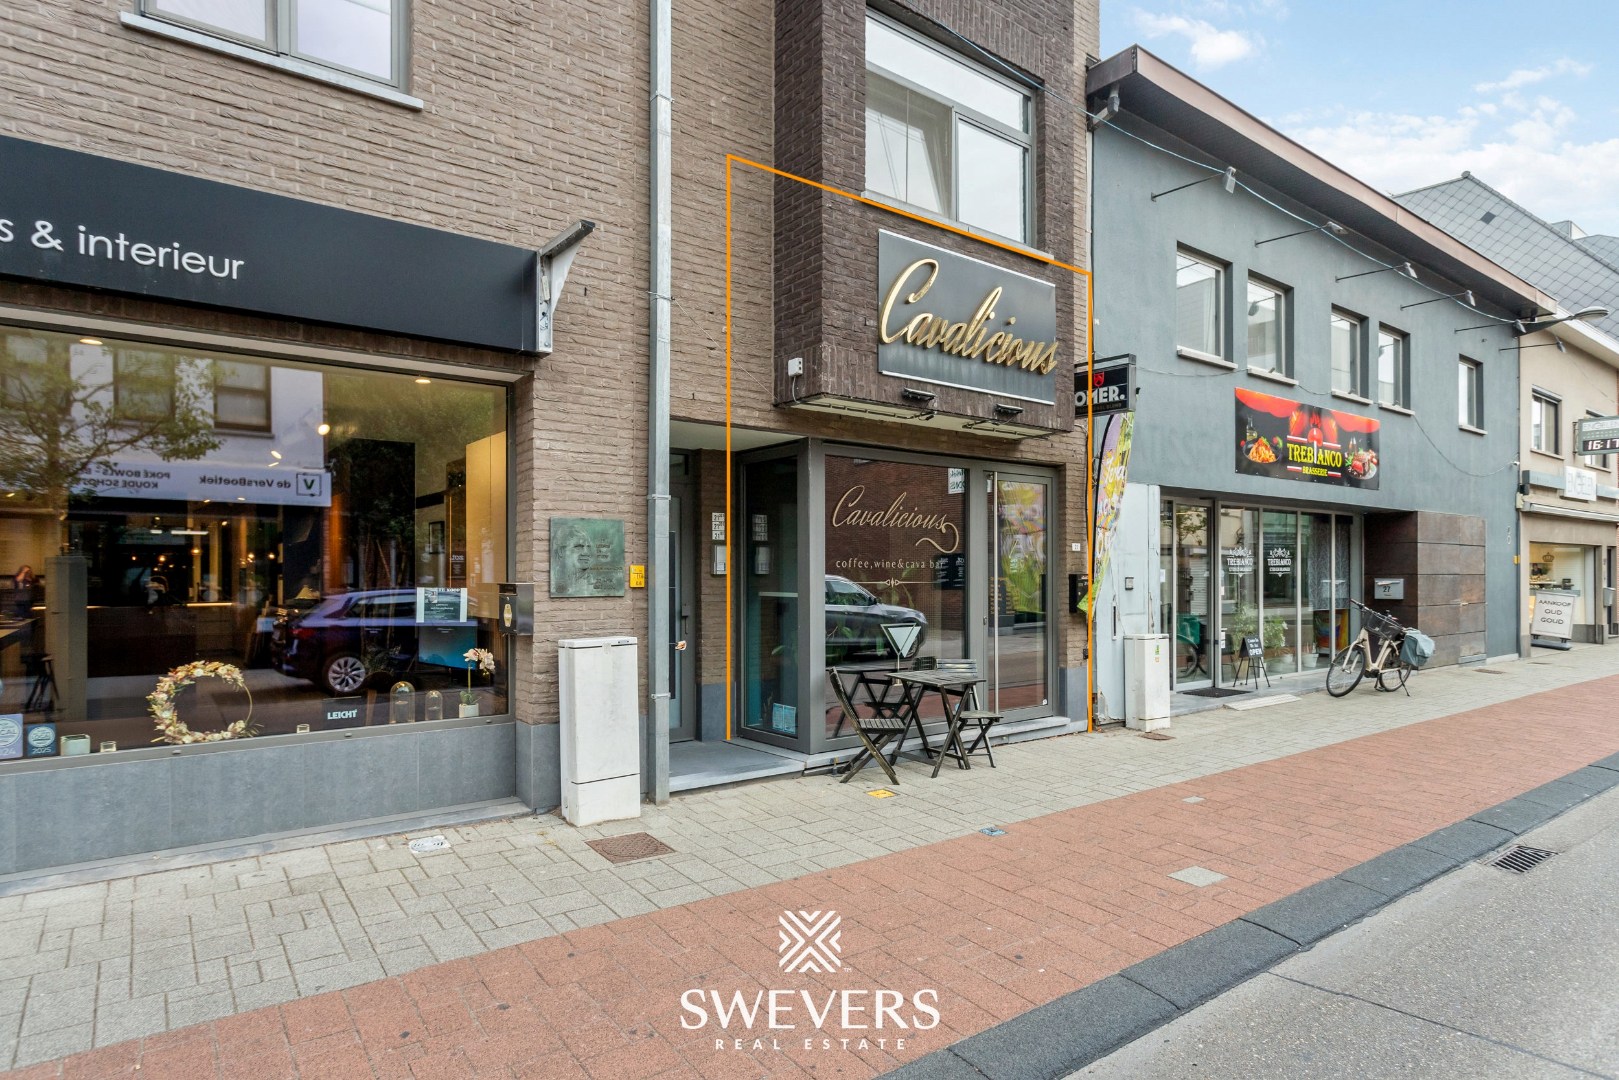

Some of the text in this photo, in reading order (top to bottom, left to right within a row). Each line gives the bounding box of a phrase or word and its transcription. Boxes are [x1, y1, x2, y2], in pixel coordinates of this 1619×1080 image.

[31, 220, 64, 252] &
[78, 225, 245, 280] interieur
[879, 258, 1060, 376] Cavalicious
[1588, 438, 1619, 451] 16:17
[1287, 443, 1342, 467] TREBIANCO
[1303, 466, 1328, 477] BRASSERIE
[833, 485, 959, 553] Cavalicious
[929, 559, 944, 569] bar
[1227, 557, 1254, 566] TREBIANCO
[1267, 558, 1292, 566] TREBIANCO
[1382, 585, 1391, 593] 27
[1544, 608, 1562, 616] OUD
[1540, 617, 1564, 625] GOUD
[1249, 648, 1262, 656] OPEN
[327, 709, 357, 720] LEICHT
[32, 746, 52, 755] 2025
